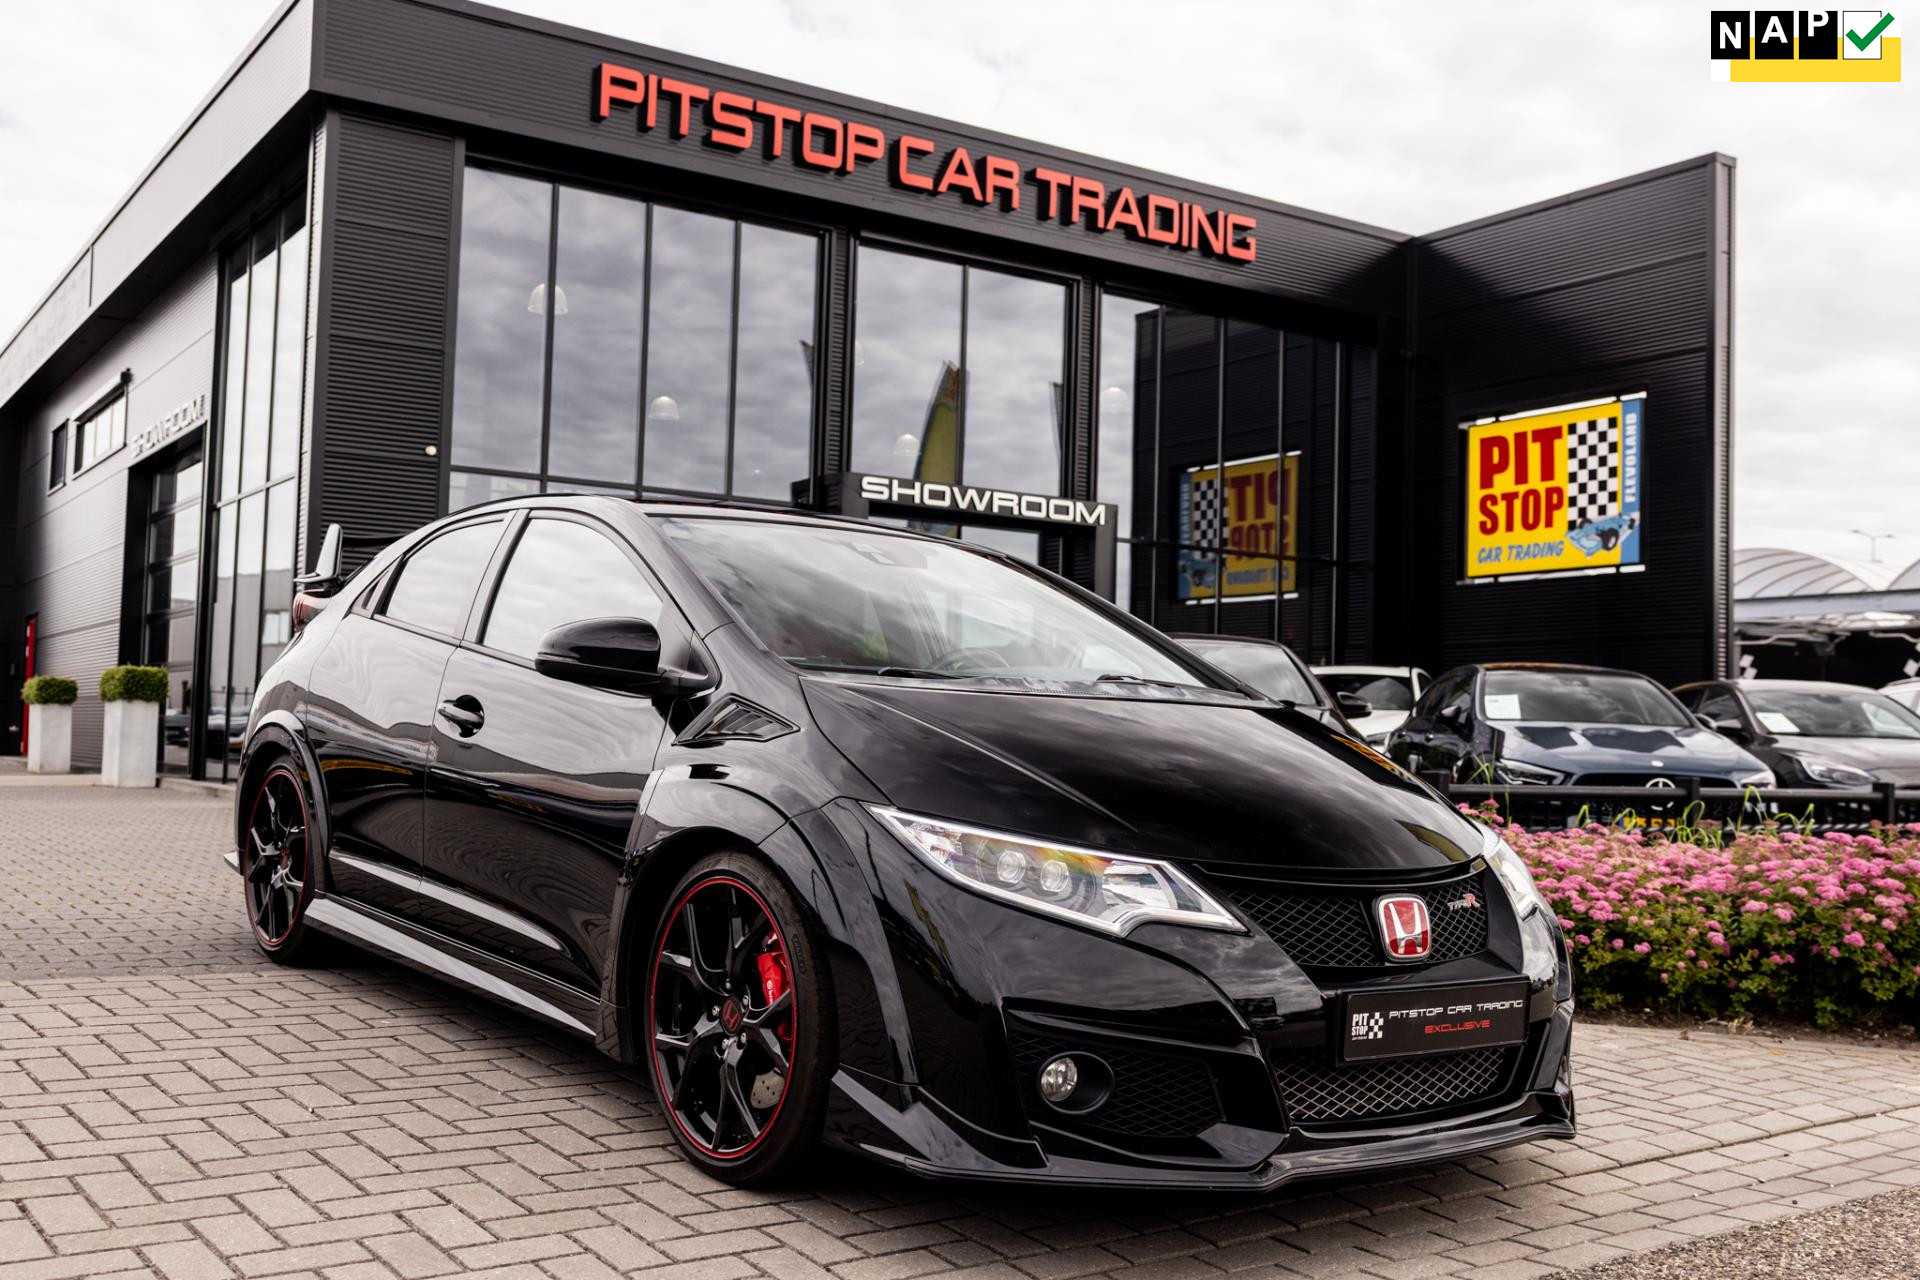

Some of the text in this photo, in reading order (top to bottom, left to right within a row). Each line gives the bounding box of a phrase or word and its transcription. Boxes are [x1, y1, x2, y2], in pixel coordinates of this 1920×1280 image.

[598, 62, 1257, 263] PITSTOP CAR TRADING
[1479, 425, 1563, 490] PIT
[1624, 412, 1637, 503] FLEVOLAND
[861, 476, 1106, 526] SHOWROOM
[1479, 486, 1565, 536] STOP
[1477, 540, 1565, 564] CAR TRADING
[1352, 1013, 1369, 1026] PIT
[1389, 1000, 1523, 1019] PITSTOP CAR TRADING
[1424, 1019, 1490, 1034] EXCLUSIVE
[1352, 1026, 1368, 1036] STOP
